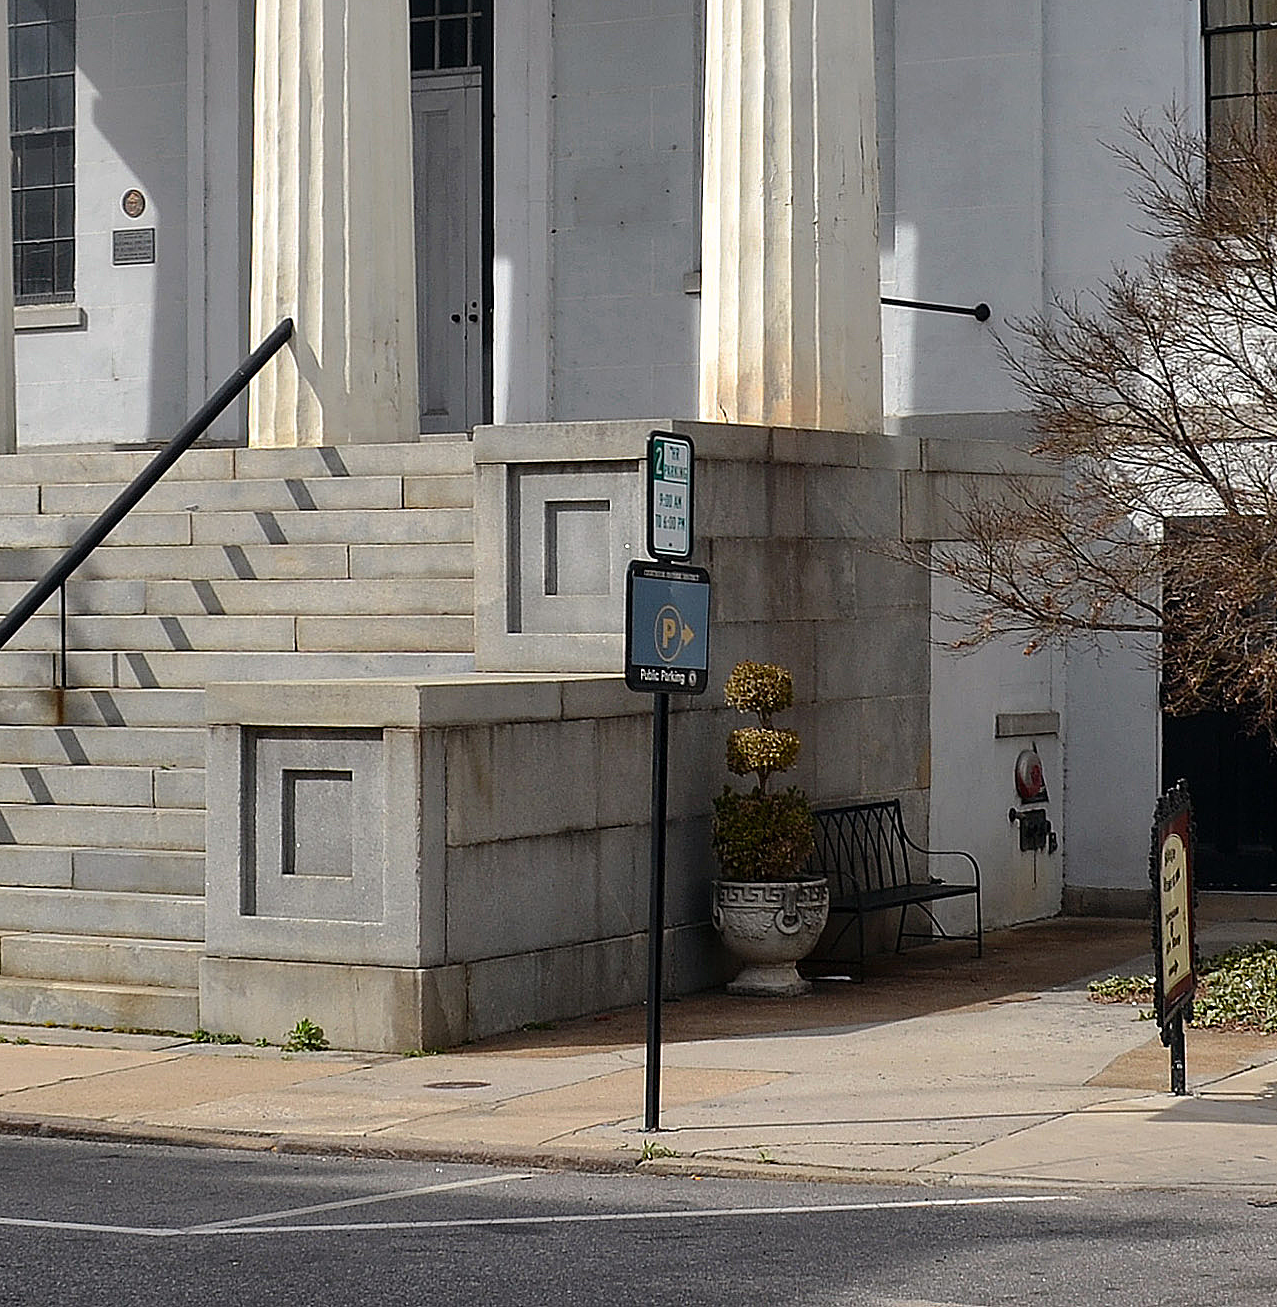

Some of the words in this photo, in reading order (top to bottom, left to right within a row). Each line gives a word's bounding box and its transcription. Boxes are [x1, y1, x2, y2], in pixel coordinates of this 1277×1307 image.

[656, 446, 663, 475] 2
[662, 618, 676, 649] P
[640, 668, 660, 682] Public
[661, 670, 686, 686] Parking
